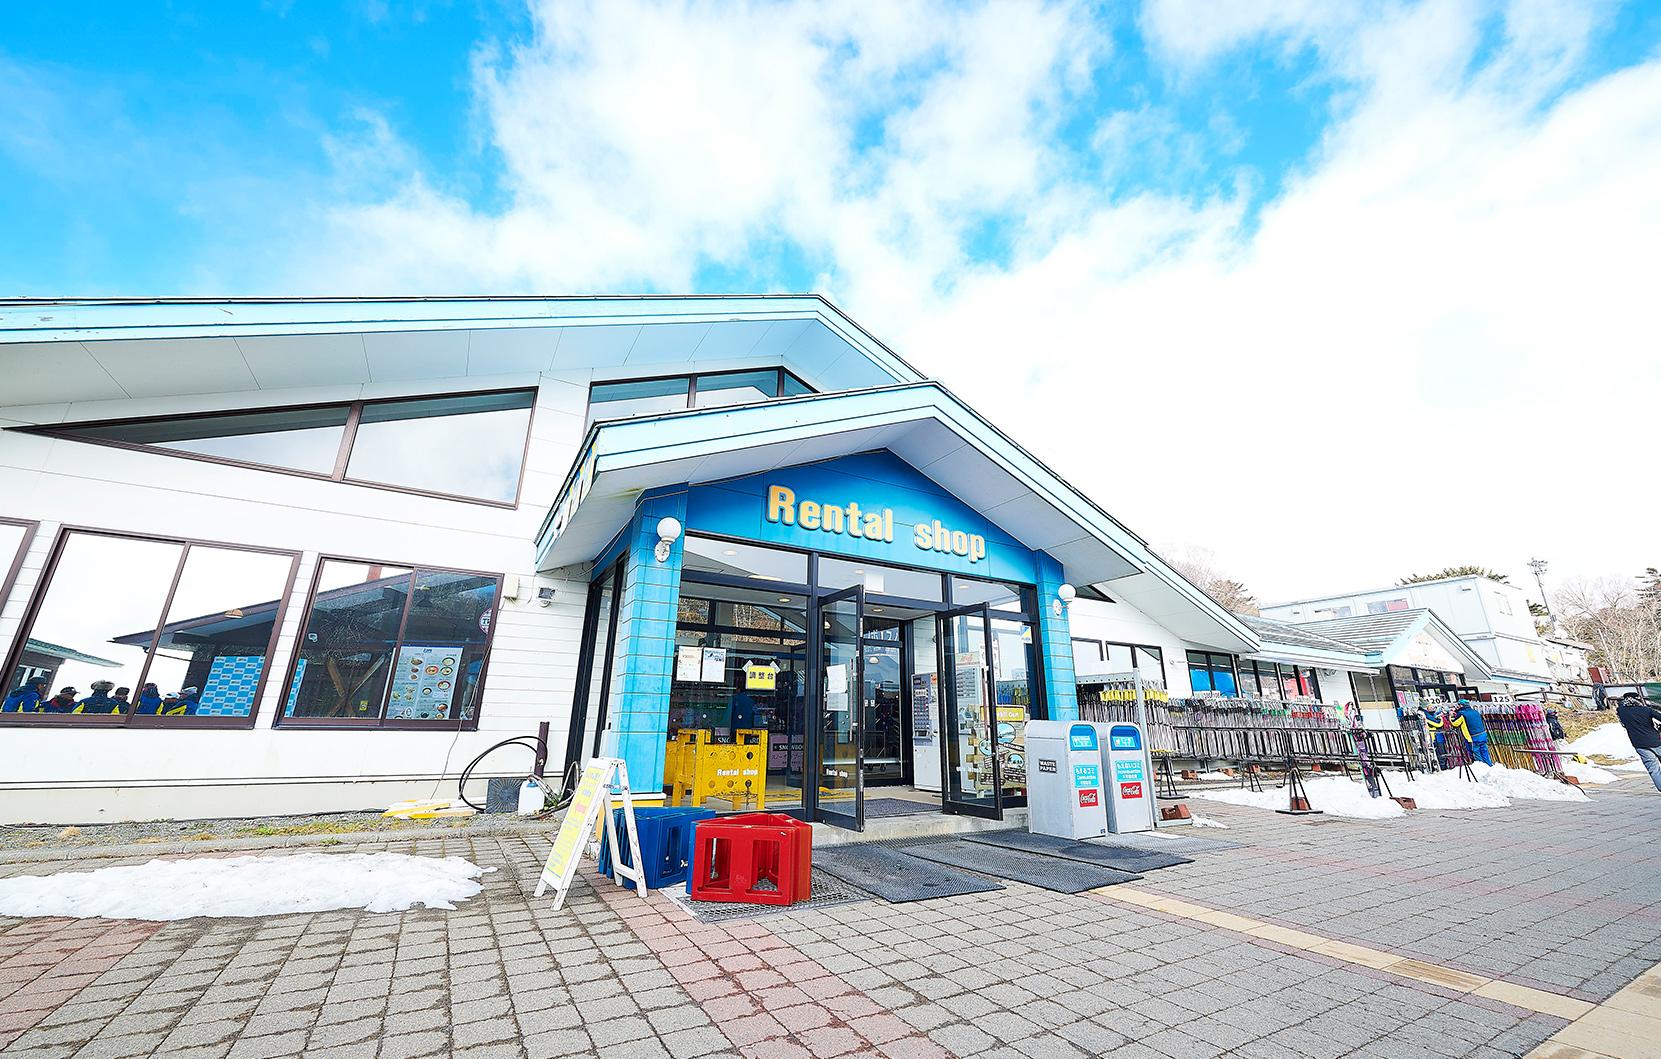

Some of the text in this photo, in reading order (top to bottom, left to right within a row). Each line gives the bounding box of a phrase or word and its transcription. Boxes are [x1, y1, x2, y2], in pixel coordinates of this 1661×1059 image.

[766, 485, 986, 563] Rental shop
[749, 671, 774, 680] 調整台
[1493, 695, 1510, 703] 125
